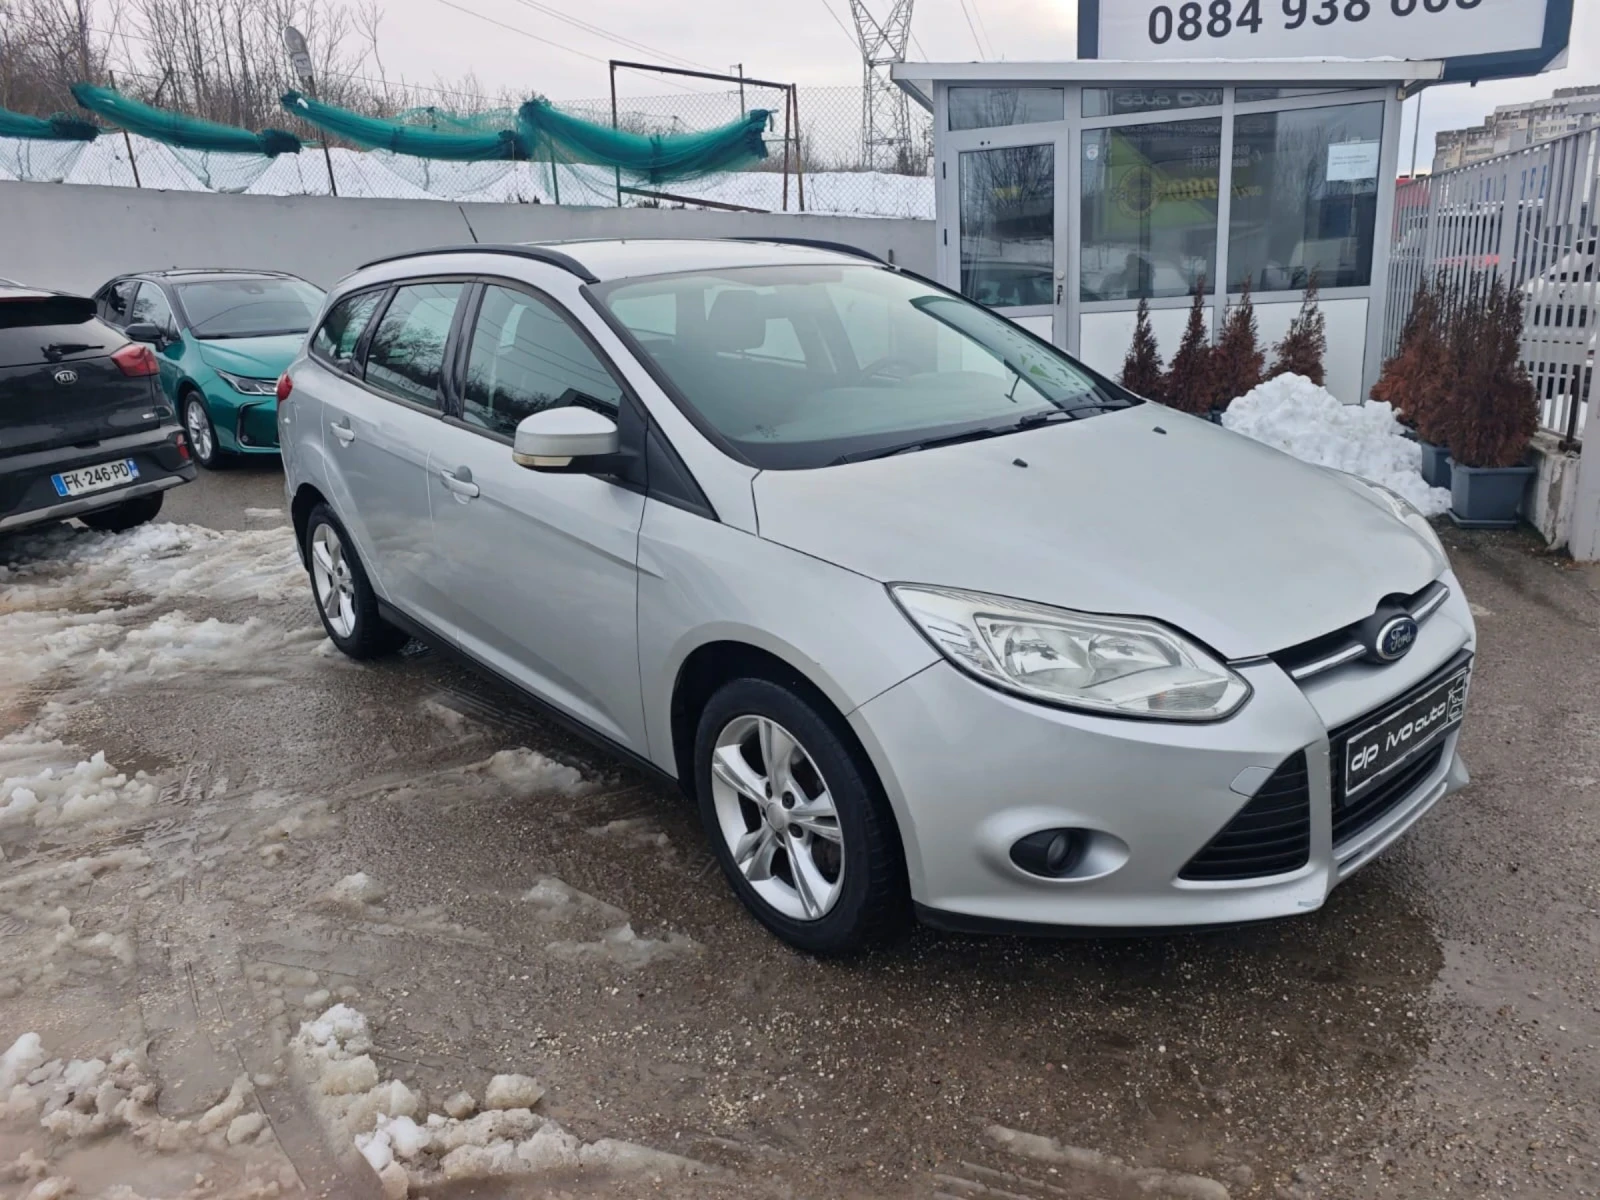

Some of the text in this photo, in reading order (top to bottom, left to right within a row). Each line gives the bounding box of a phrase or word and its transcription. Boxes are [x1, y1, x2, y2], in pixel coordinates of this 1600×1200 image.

[1148, 0, 1263, 45] 0884
[1390, 625, 1411, 651] Ford
[1386, 722, 1413, 751] ivo
[1414, 703, 1446, 732] auto
